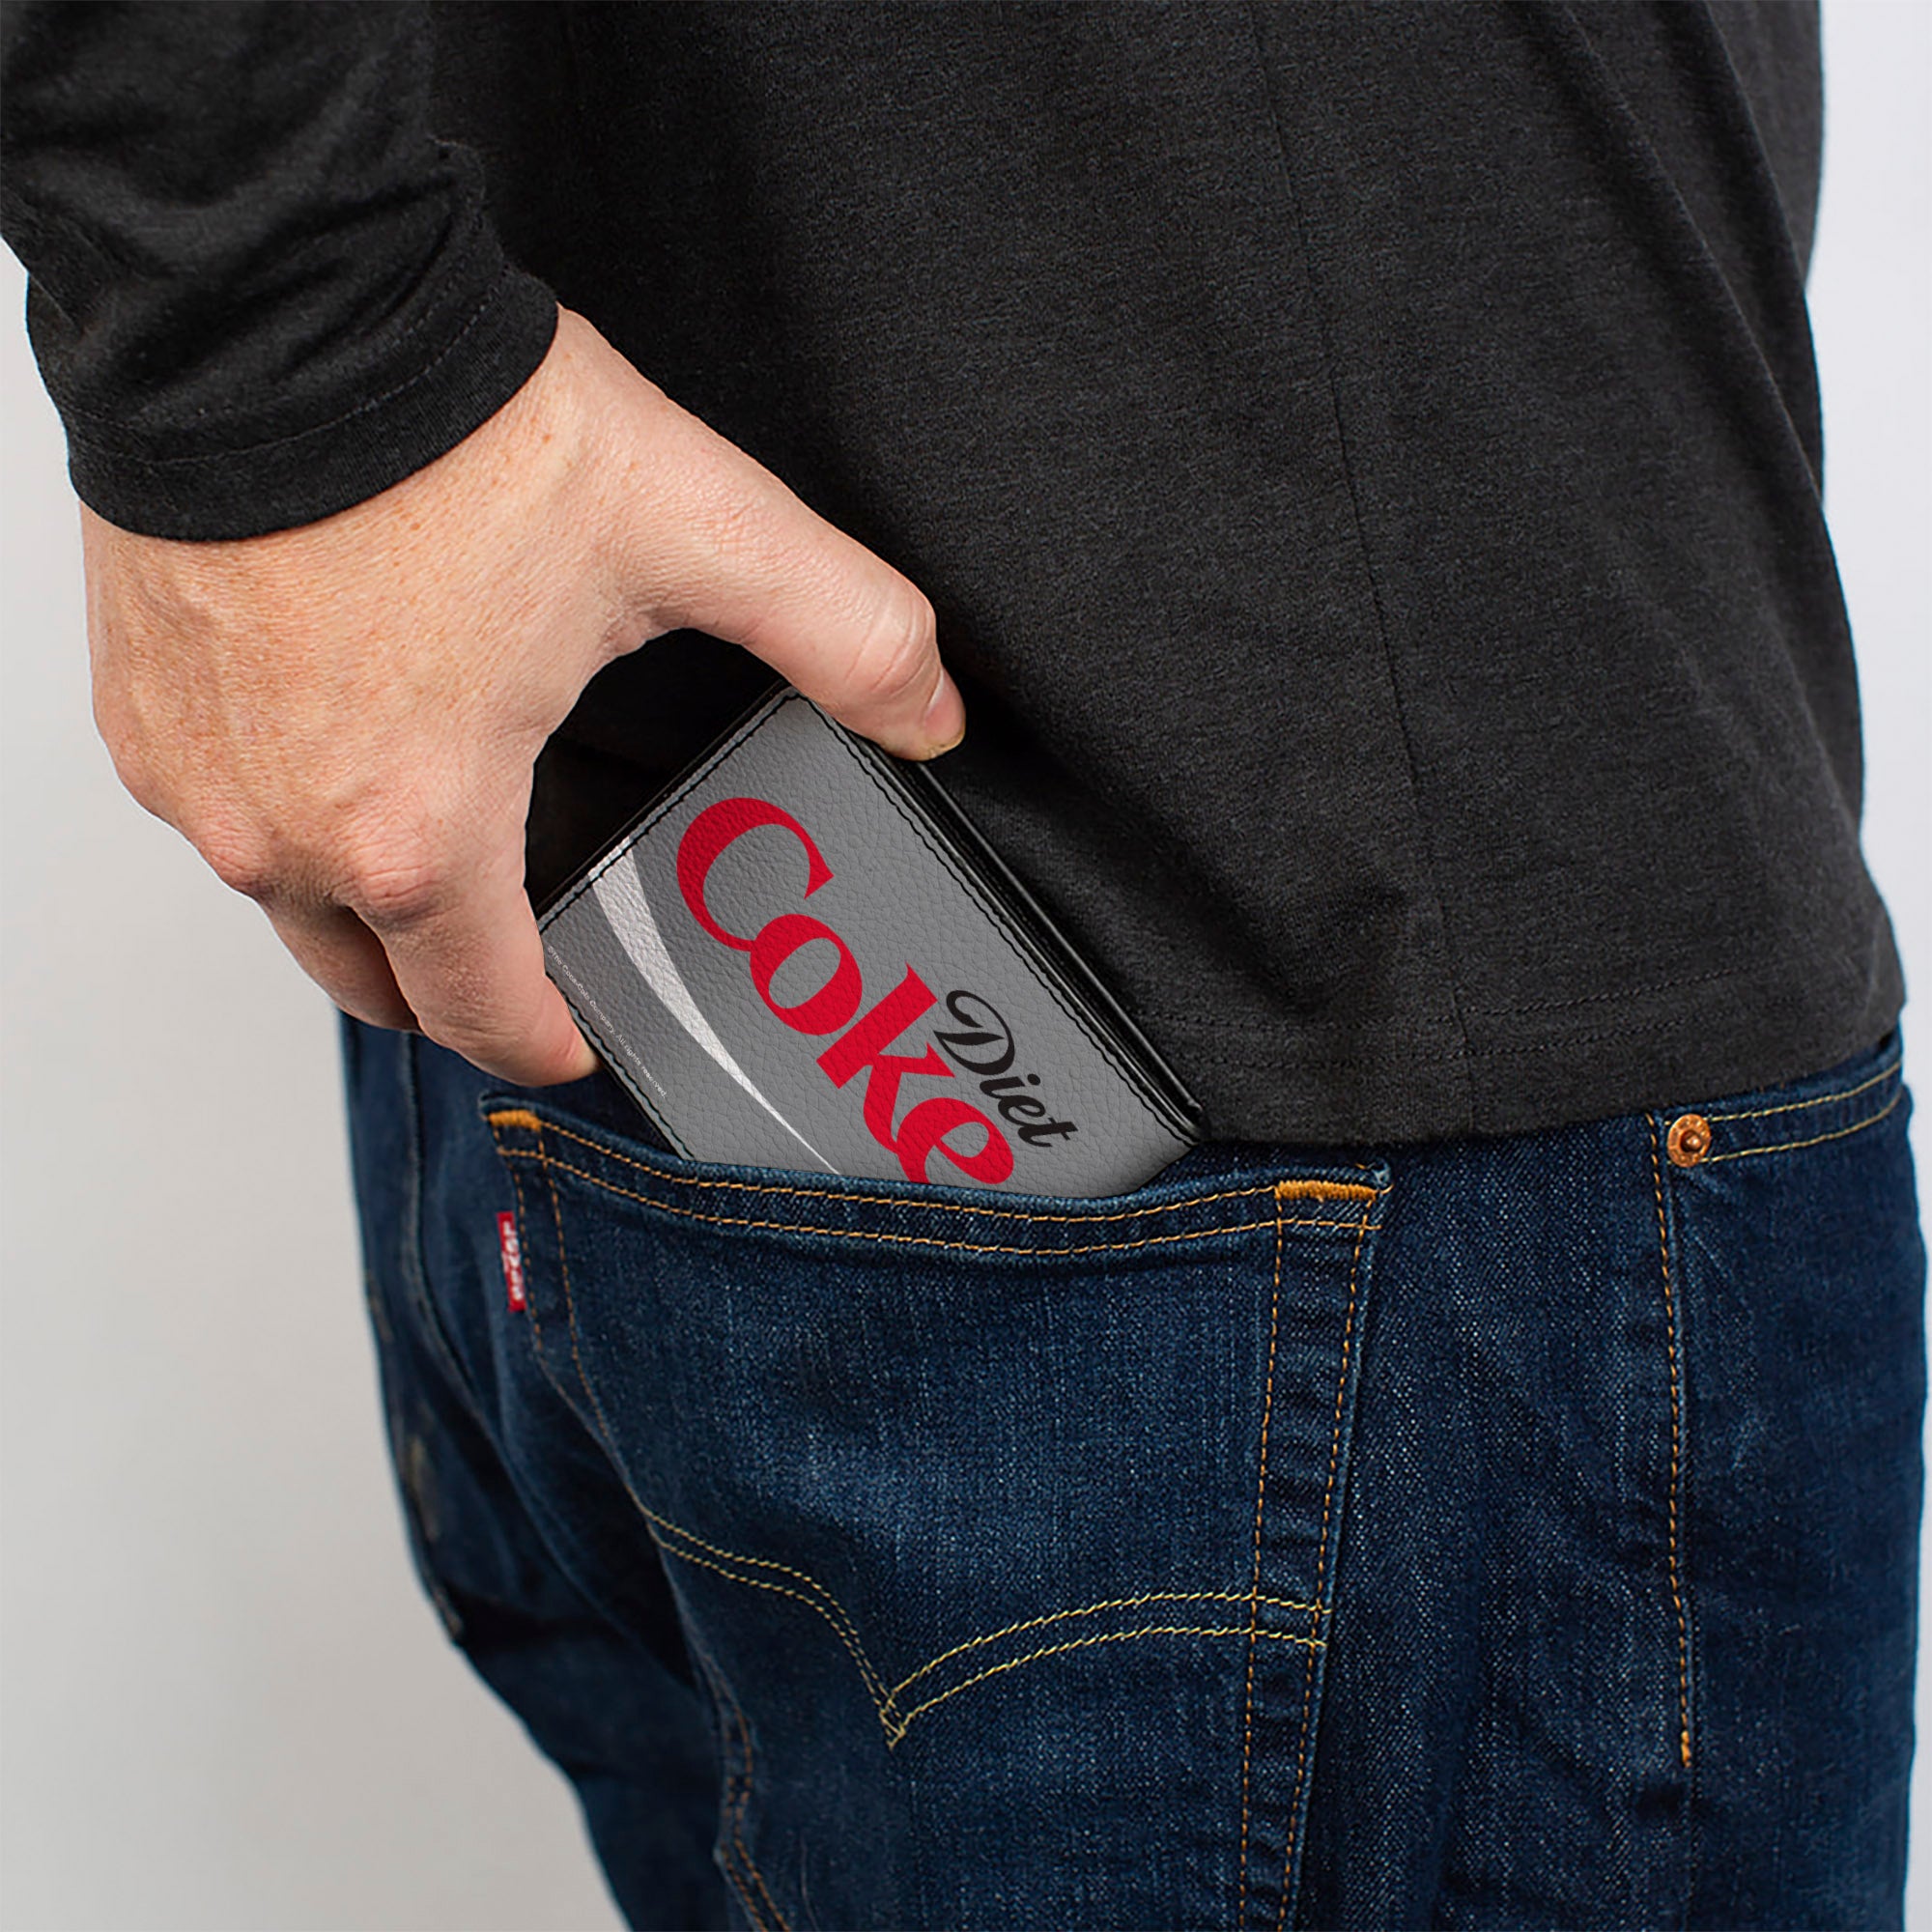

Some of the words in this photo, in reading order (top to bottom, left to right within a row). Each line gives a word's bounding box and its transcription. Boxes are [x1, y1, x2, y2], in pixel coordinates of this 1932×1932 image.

[562, 964, 591, 1001] Coca-Cola
[624, 1044, 642, 1066] rights
[676, 798, 1014, 1184] Coke
[933, 989, 1079, 1148] Diet
